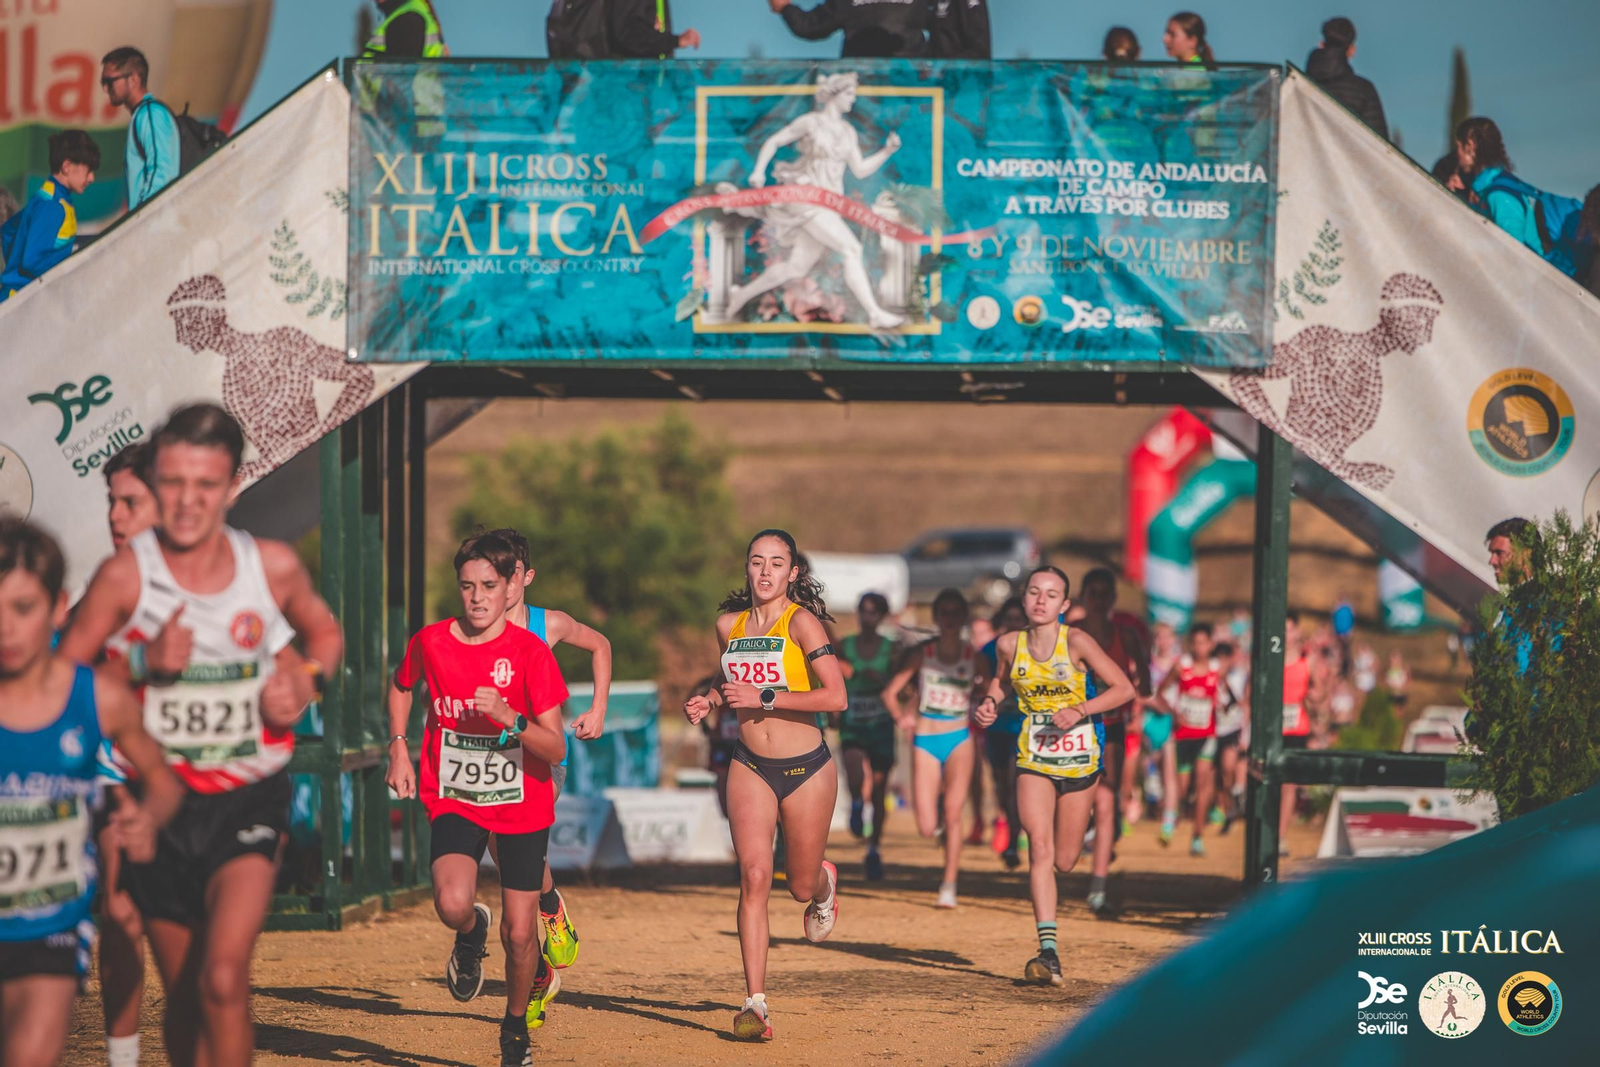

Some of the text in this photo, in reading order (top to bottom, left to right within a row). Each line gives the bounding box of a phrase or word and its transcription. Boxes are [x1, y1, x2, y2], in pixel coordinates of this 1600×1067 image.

[500, 153, 608, 181] CROSS
[957, 158, 1268, 183] CAMPEONATO DE ANDALUCÍA
[501, 182, 645, 197] INTERNACIONAL
[1058, 177, 1166, 199] DE CAMPO
[1004, 195, 1230, 220] A TRAVÉS POR CLUBES
[368, 192, 644, 257] ITÁLICA
[990, 236, 1010, 257] Y
[1016, 235, 1033, 257] 9
[1040, 235, 1075, 258] DE
[1083, 235, 1252, 265] NOVIEMBRE
[368, 259, 505, 275] INTERNATIONAL
[61, 406, 133, 461] Diputación
[72, 422, 144, 477] Sevilla
[1271, 636, 1281, 653] 2
[728, 662, 780, 684] 5285
[161, 702, 253, 734] 5821
[1035, 734, 1087, 752] 7361
[449, 759, 517, 784] 7950
[1263, 867, 1272, 883] 2
